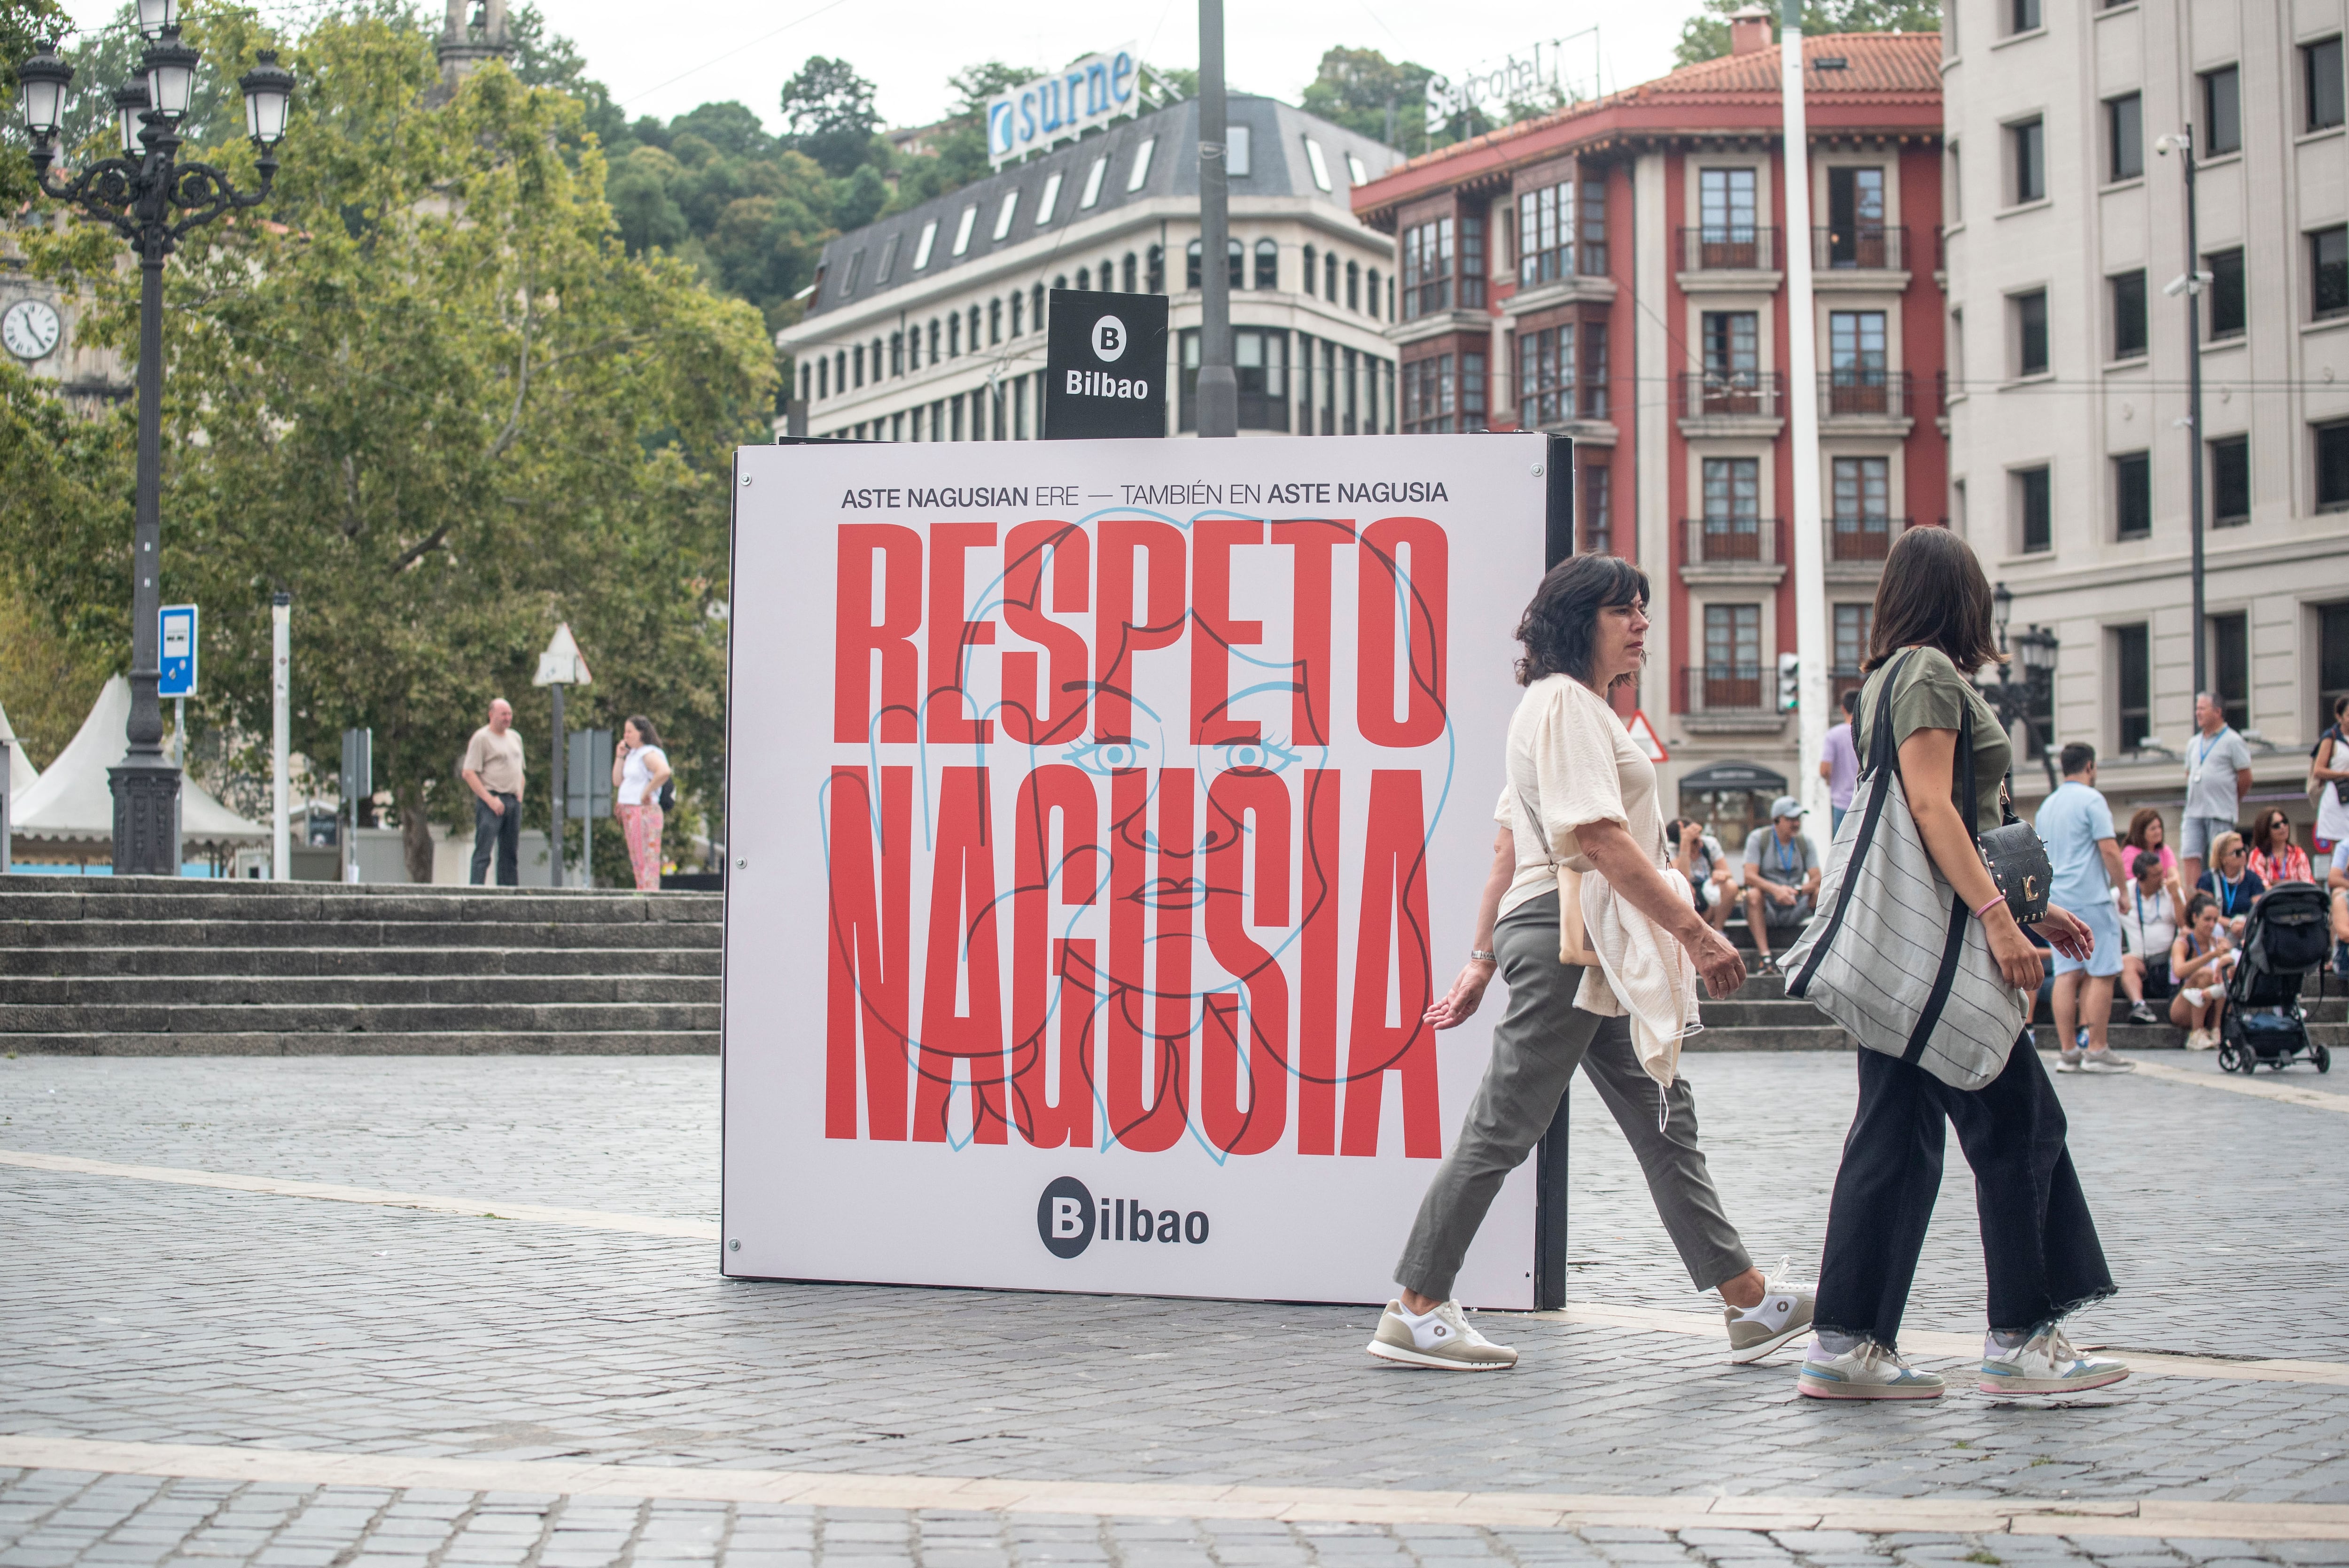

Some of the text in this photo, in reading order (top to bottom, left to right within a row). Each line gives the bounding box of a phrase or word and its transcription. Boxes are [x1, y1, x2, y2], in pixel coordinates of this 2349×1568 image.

[1020, 51, 1131, 141] surne
[1100, 326, 1120, 350] B
[1066, 370, 1148, 399] Bilbao
[841, 489, 901, 509] ASTE
[908, 487, 1028, 508] NAGUSIAN
[1036, 486, 1079, 506] ERE
[1120, 480, 1222, 505] TAMBIÉN
[1230, 484, 1260, 504] EN
[1268, 483, 1330, 504] ASTE
[1338, 481, 1448, 503] NAGUSIA
[834, 517, 1448, 748] RESPETO
[825, 764, 1442, 1159] NAGUSIA
[1051, 1196, 1209, 1244] Bilbao
